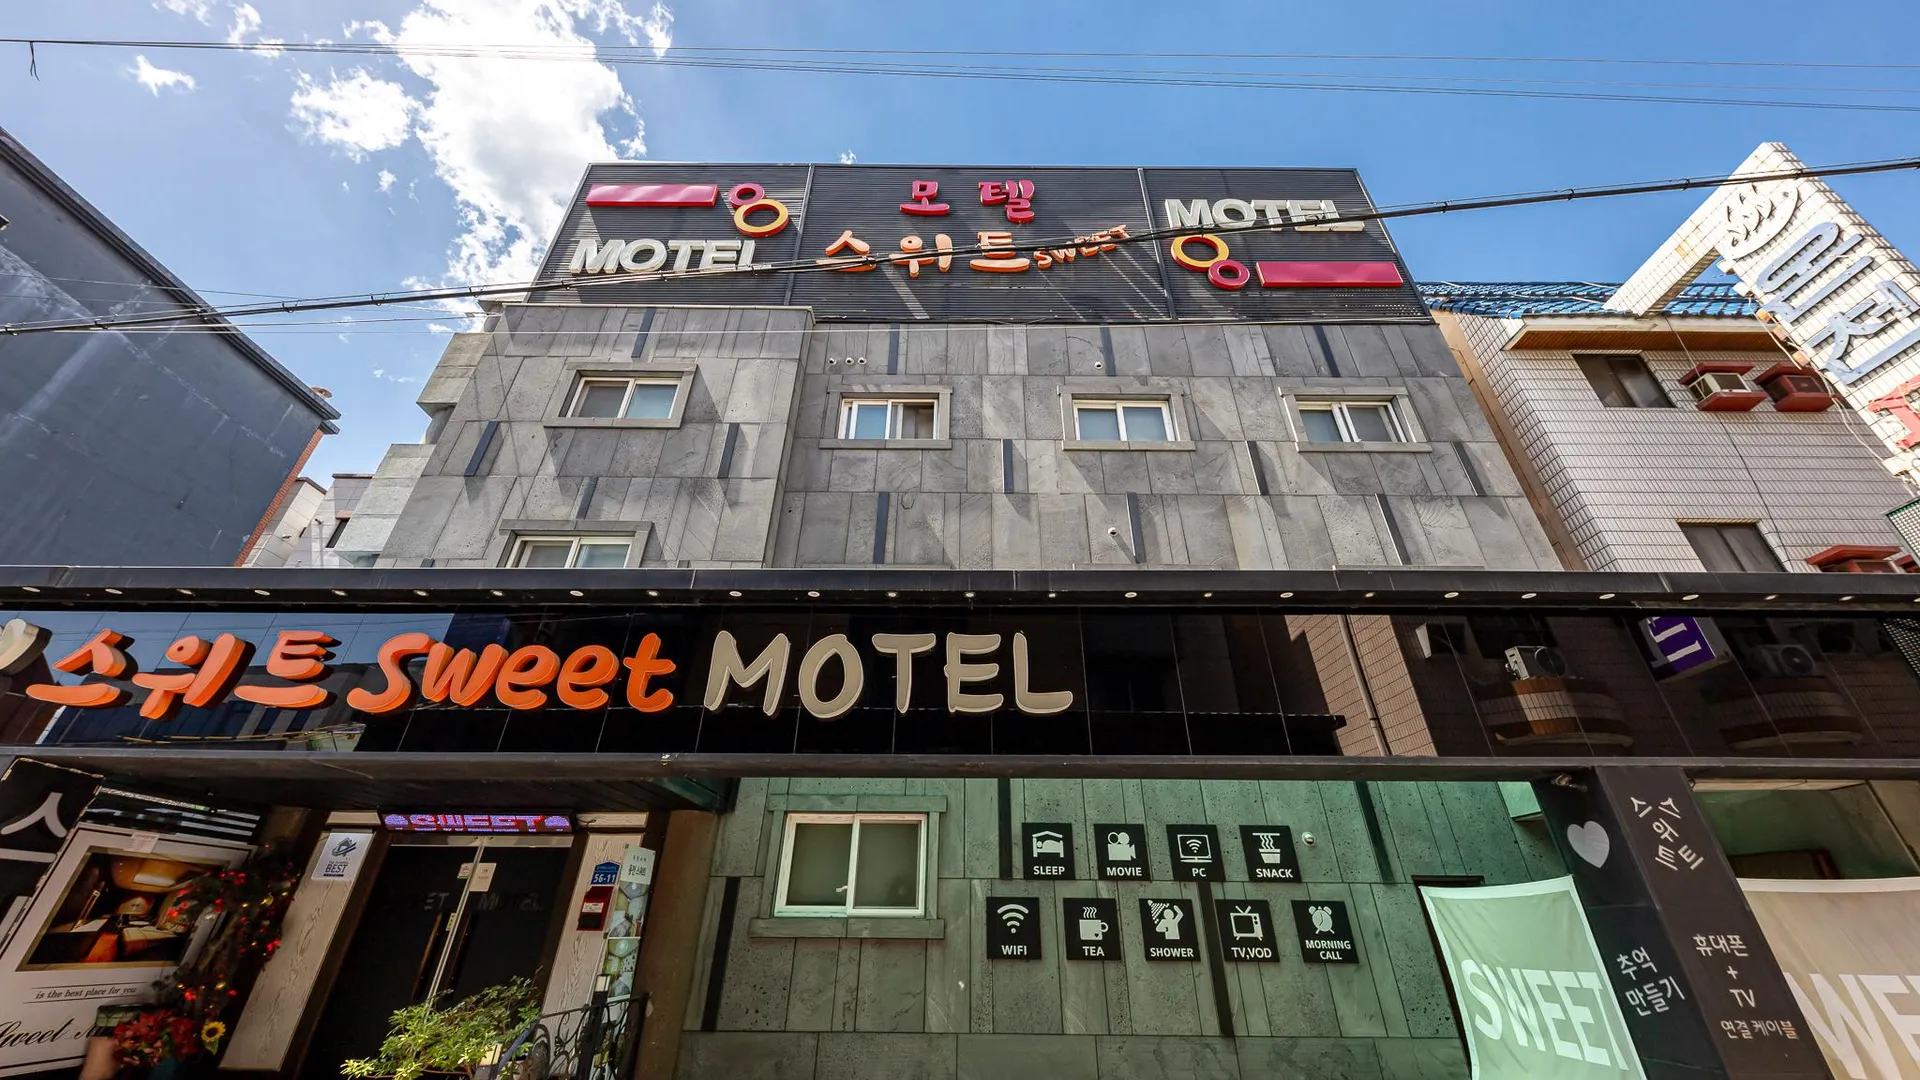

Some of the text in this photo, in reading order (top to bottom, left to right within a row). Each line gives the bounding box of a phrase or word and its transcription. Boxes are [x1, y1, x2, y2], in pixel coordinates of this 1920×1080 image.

[900, 180, 1035, 222] 모텔
[1164, 198, 1365, 231] MOTEL
[816, 230, 1030, 278] 스위트
[26, 629, 1074, 720] 스위트 Sweet MOTEL
[325, 864, 349, 873] BEST
[1033, 865, 1065, 876] SLEEP
[1106, 867, 1142, 877] MOVIE
[1191, 868, 1207, 878] PC
[1256, 868, 1293, 879] SNACK
[593, 874, 616, 883] 56-11
[1001, 944, 1027, 956] WIFI
[1305, 939, 1351, 950] MORNING
[1692, 933, 1749, 957] 휴대폰
[1082, 946, 1105, 957] TEA
[1150, 947, 1194, 958] SHOWER
[1231, 947, 1272, 959] TV,VOD
[1319, 950, 1343, 960] CALL
[1616, 946, 1658, 981] 추억
[47, 989, 63, 998] the
[65, 988, 83, 997] best
[85, 988, 107, 997] place
[109, 985, 120, 995] for
[122, 986, 137, 996] you
[1624, 975, 1686, 1017] 만들기
[1729, 988, 1756, 1008] TV
[1460, 958, 1630, 1071] SWEET
